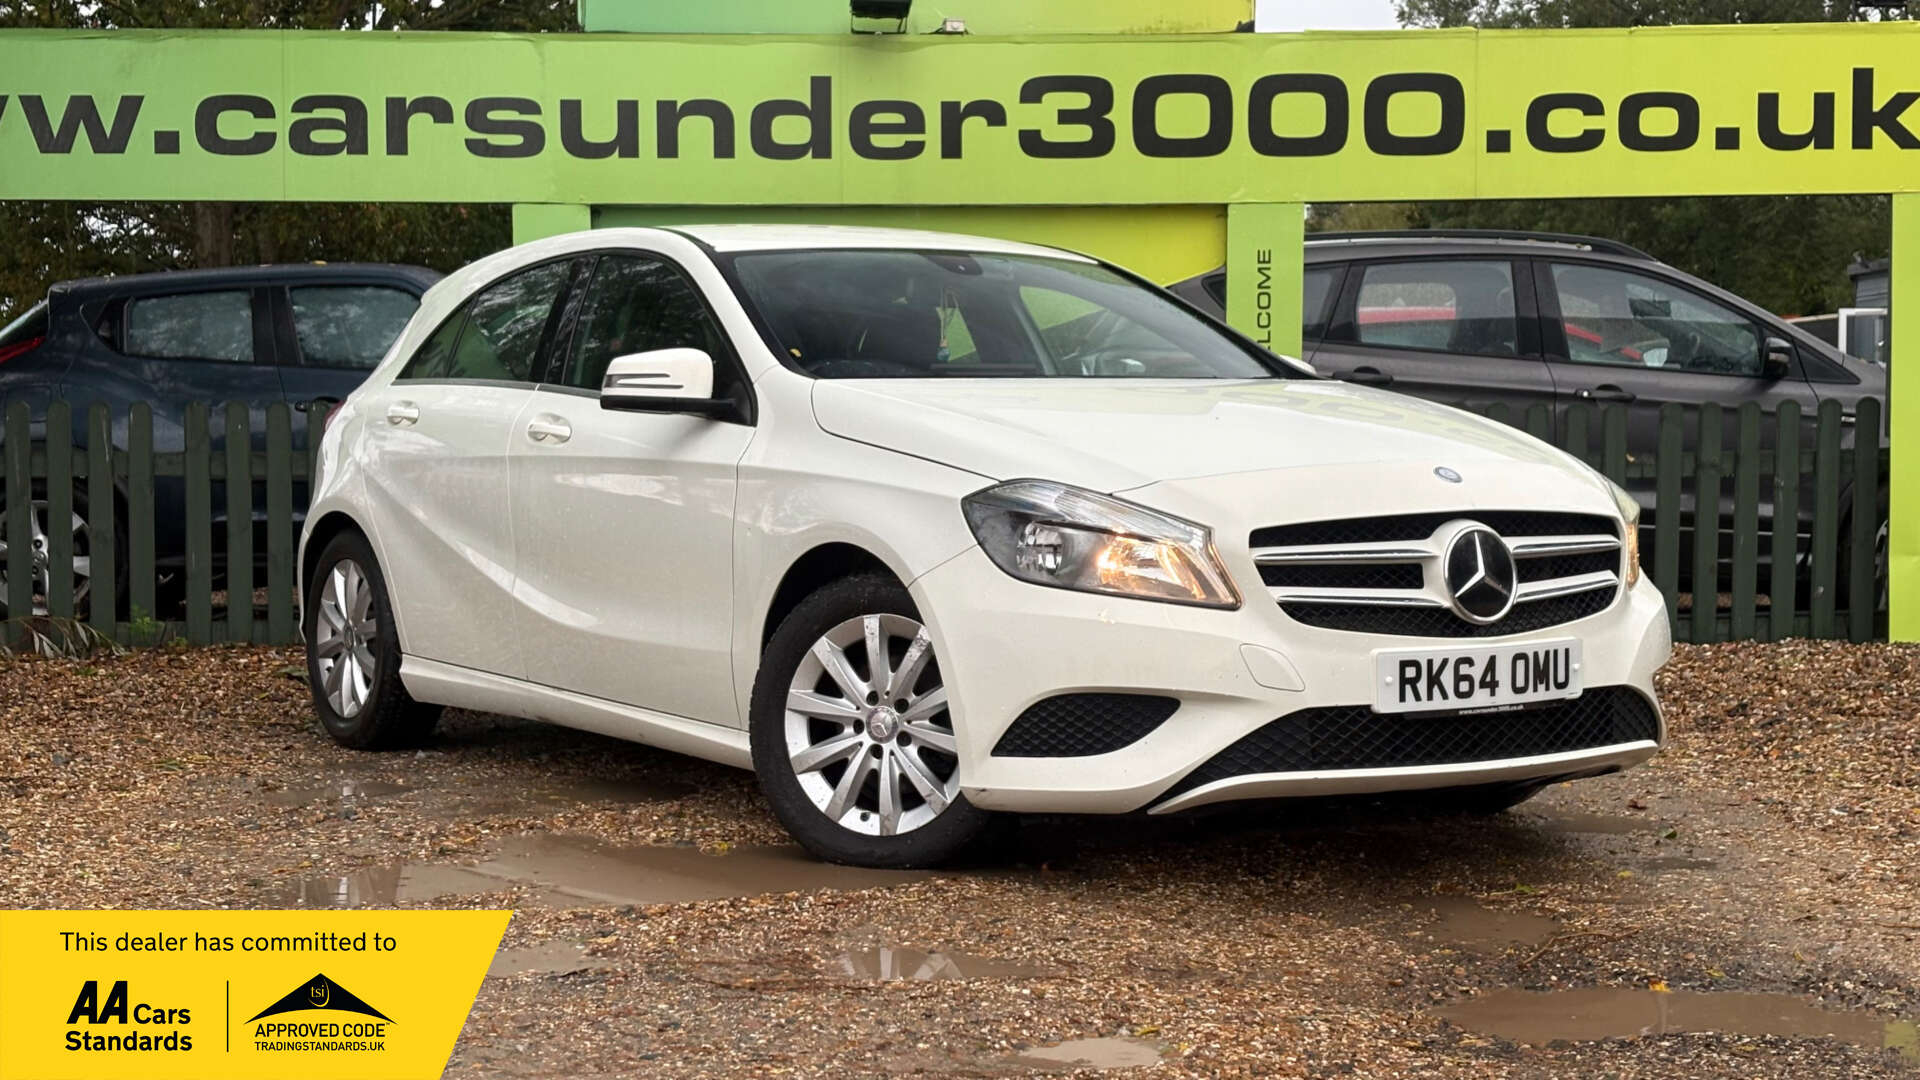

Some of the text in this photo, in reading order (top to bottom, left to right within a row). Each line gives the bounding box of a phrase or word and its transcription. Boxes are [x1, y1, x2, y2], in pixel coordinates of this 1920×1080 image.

[0, 67, 1920, 160] w.carsunder3000.co.uk
[1257, 249, 1271, 351] LCOME
[1398, 647, 1571, 703] RK64 OMU
